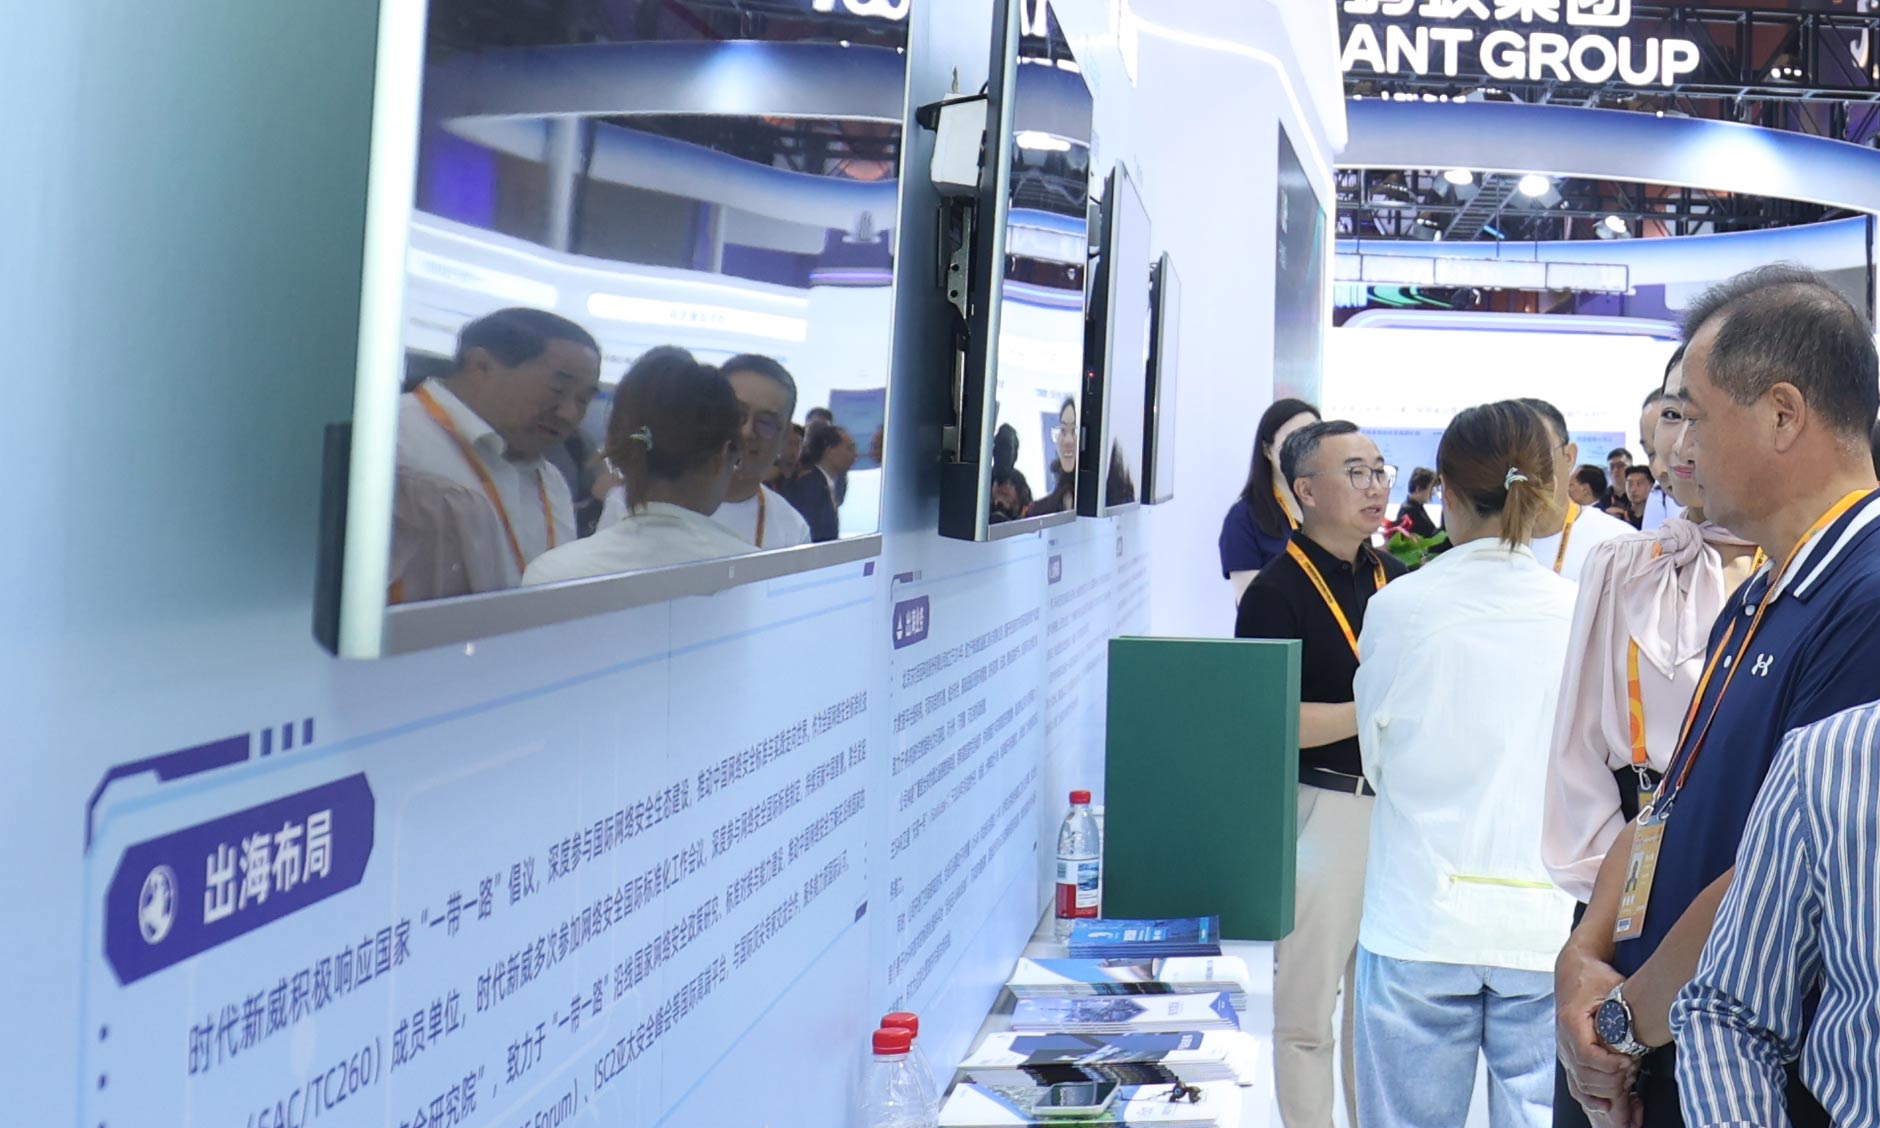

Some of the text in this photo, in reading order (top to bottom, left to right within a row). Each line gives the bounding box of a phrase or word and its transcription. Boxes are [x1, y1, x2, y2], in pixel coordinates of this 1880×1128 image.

[1340, 23, 1700, 86] ANT GROUP
[204, 808, 331, 925] 出海布局
